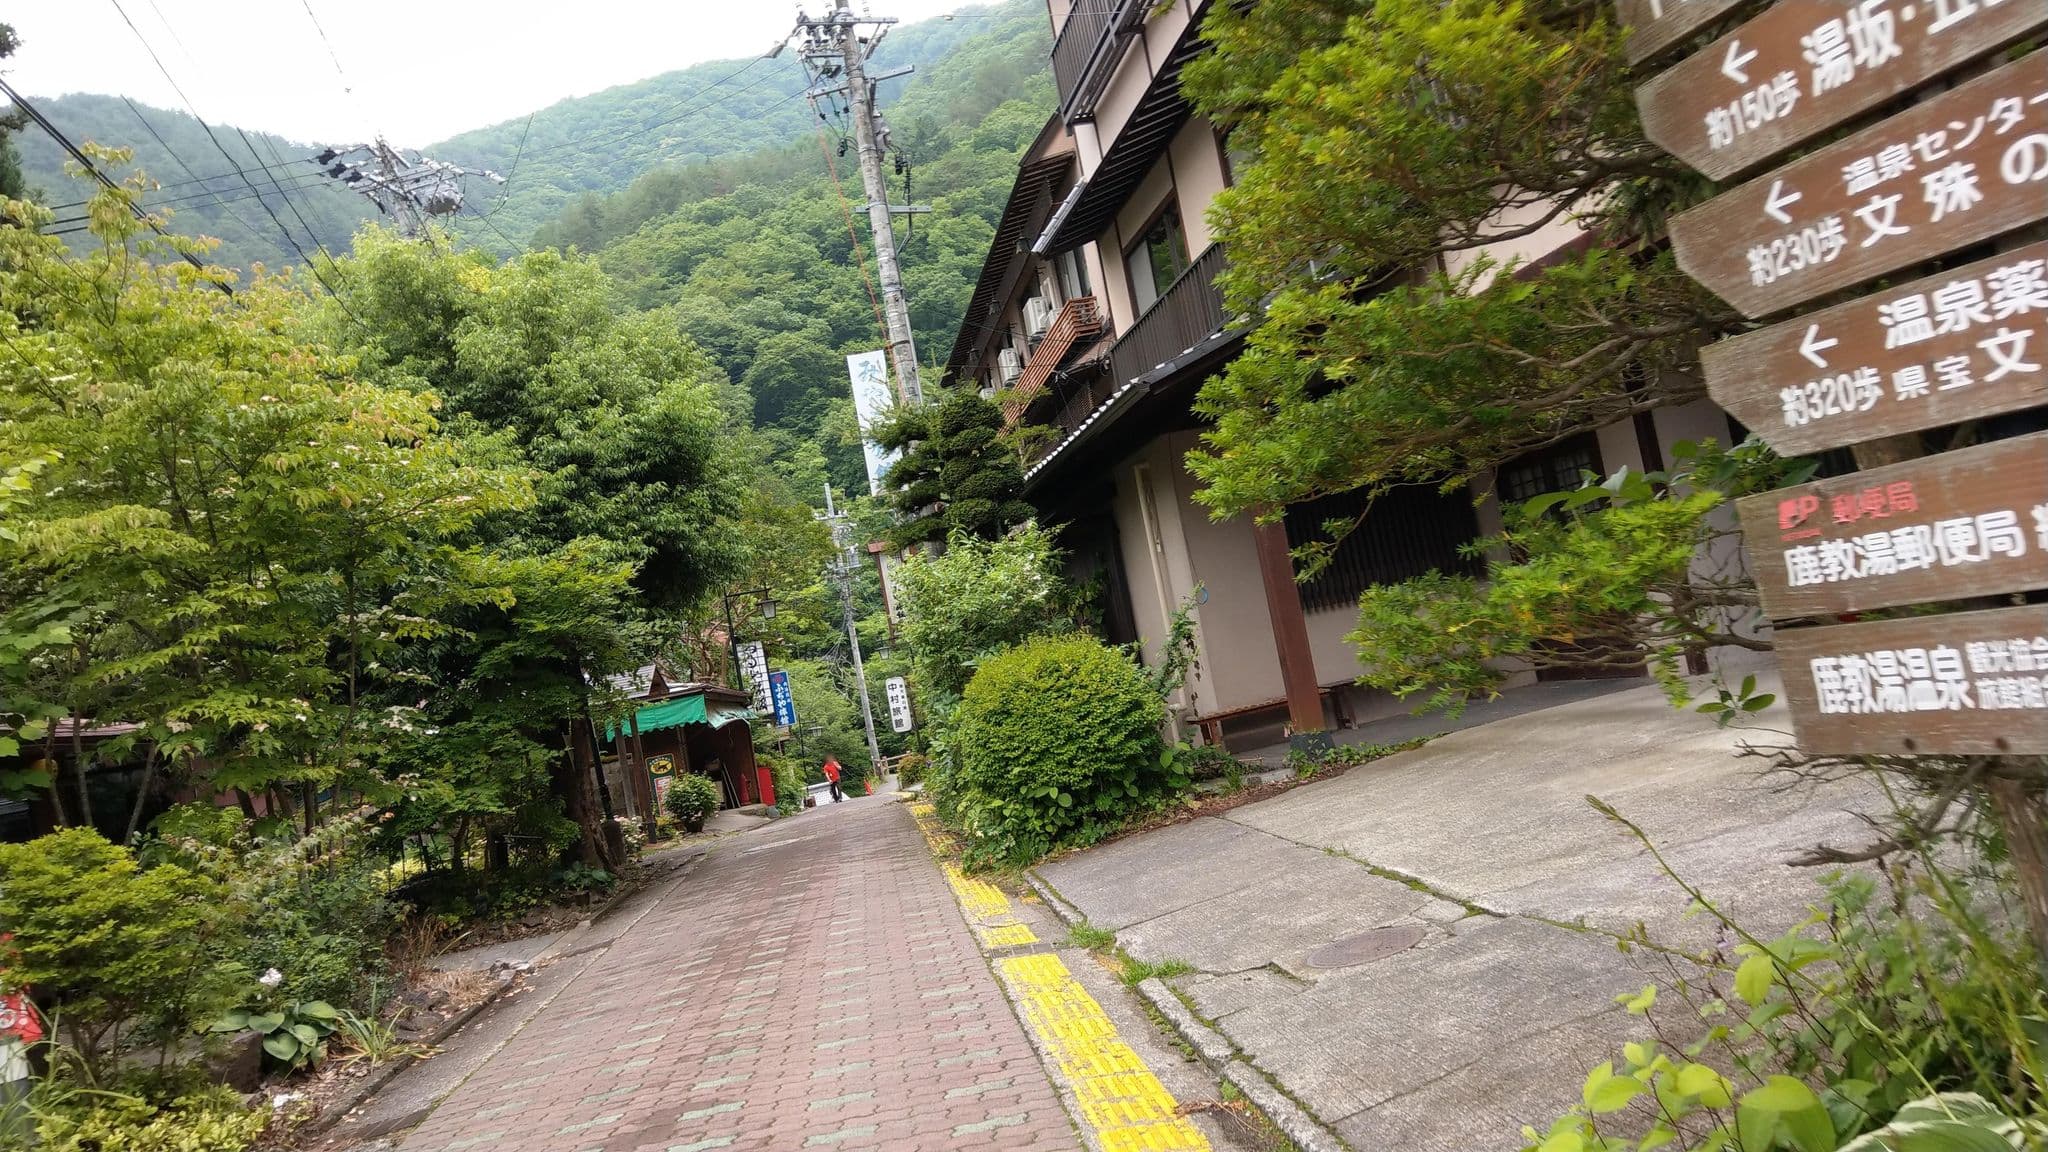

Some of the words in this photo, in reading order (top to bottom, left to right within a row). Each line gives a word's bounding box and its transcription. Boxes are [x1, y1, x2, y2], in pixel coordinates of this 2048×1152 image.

[1704, 69, 1803, 151] 約150歩
[1842, 92, 2048, 196] 温泉センター
[1746, 215, 1848, 288] 約230歩
[1779, 366, 1885, 428] 約320歩
[1783, 510, 2027, 587] 鹿教湯郵便局
[887, 683, 905, 729] 中村旅館
[1809, 644, 1976, 714] 鹿教湯温泉
